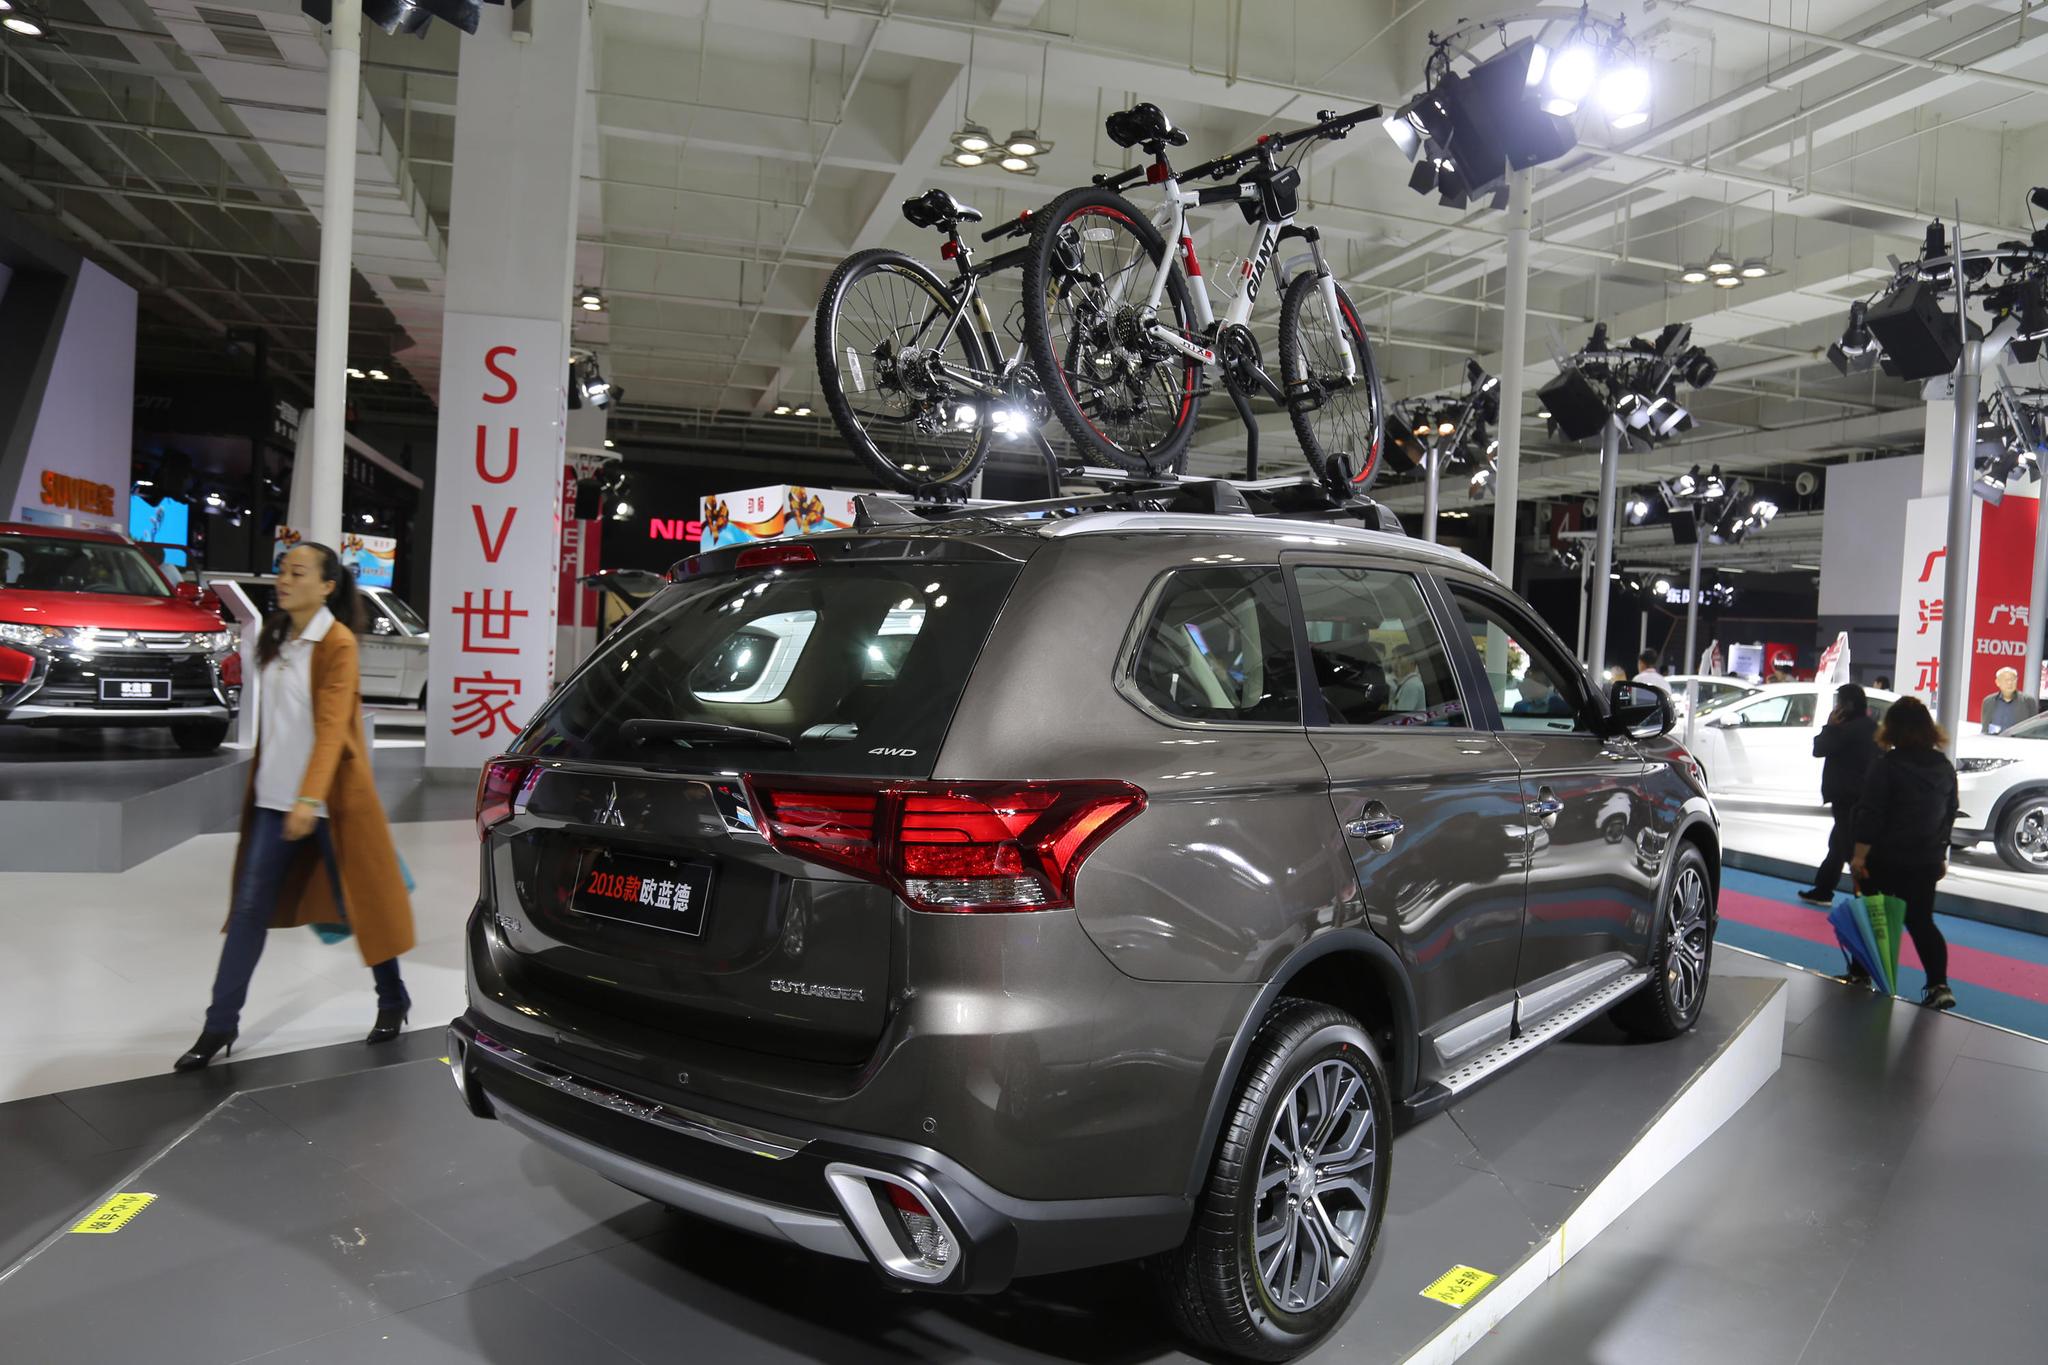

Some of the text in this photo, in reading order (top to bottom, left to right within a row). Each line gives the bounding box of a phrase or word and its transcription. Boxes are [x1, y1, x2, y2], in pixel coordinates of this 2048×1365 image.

[1246, 228, 1276, 304] GIANT
[450, 345, 529, 740] SUV世家
[868, 747, 917, 757] 4WD
[587, 871, 692, 912] 2018款欧蓝德
